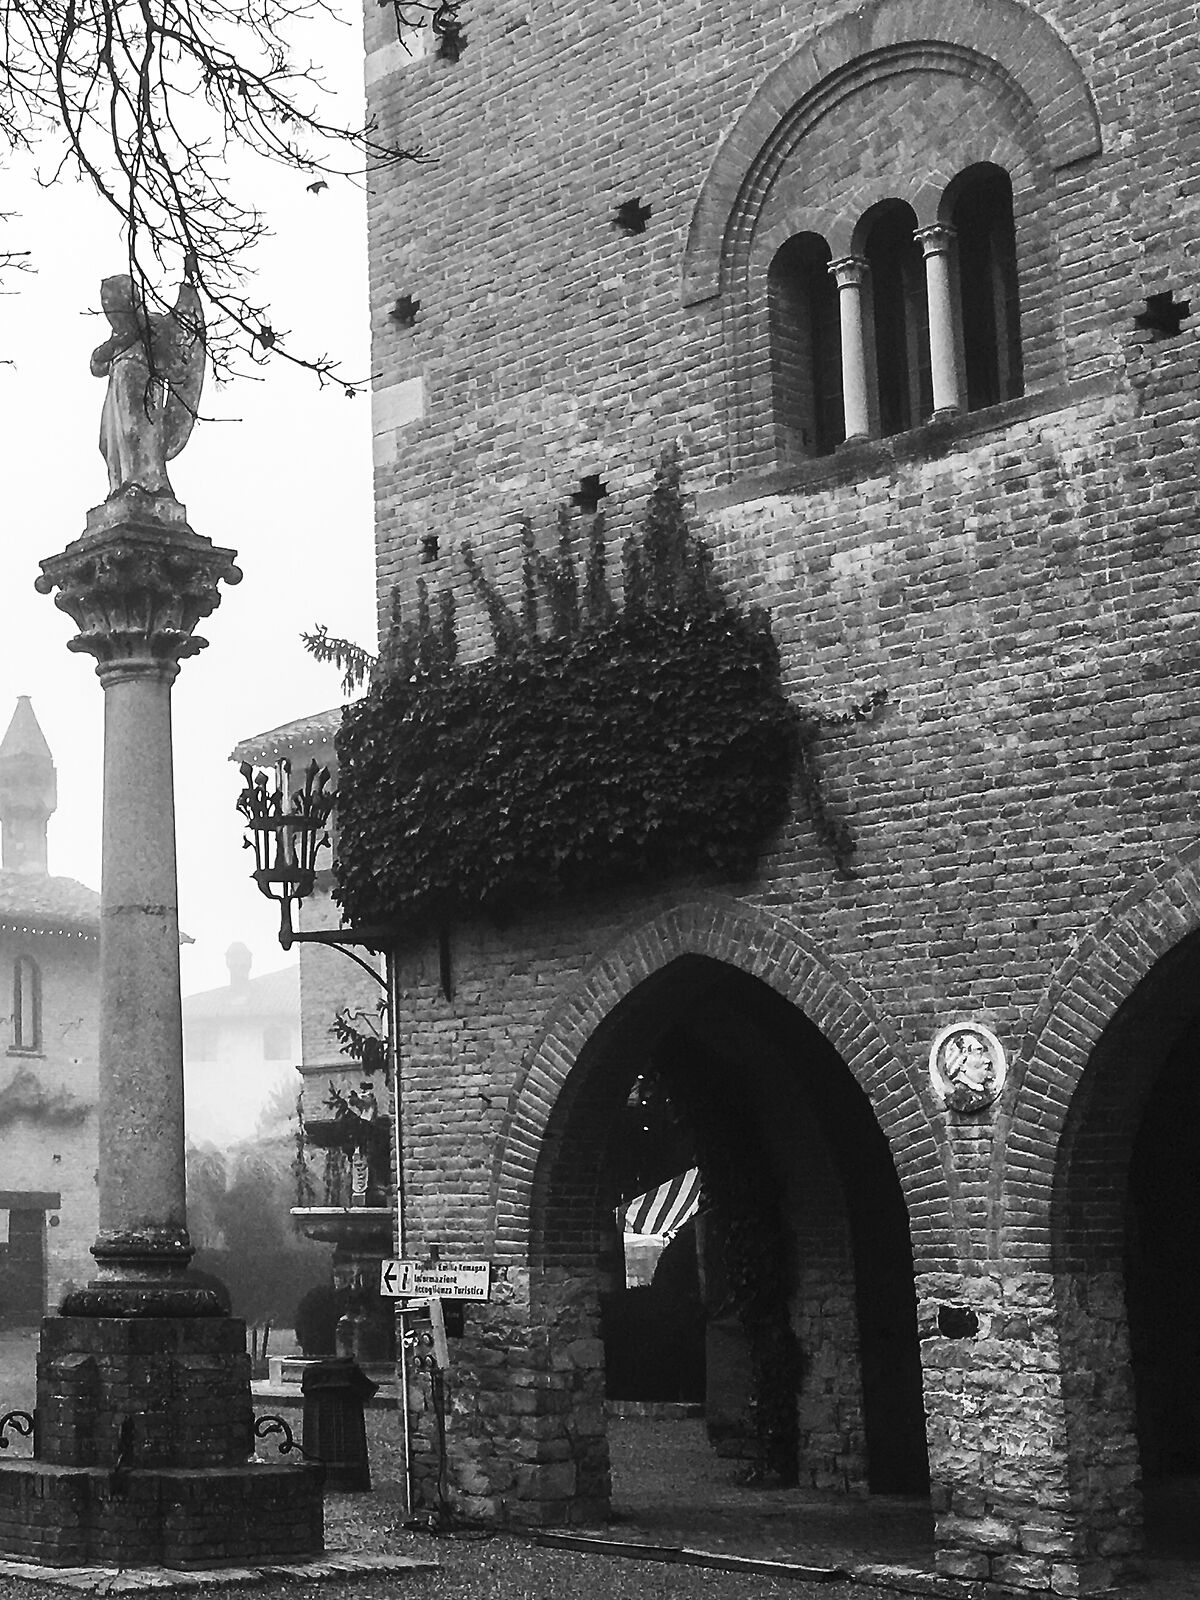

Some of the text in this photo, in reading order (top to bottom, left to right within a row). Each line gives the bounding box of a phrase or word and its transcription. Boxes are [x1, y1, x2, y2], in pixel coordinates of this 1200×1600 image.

[459, 1263, 486, 1273] Romagna
[414, 1274, 457, 1283] Informazione
[454, 1286, 483, 1295] Turistica
